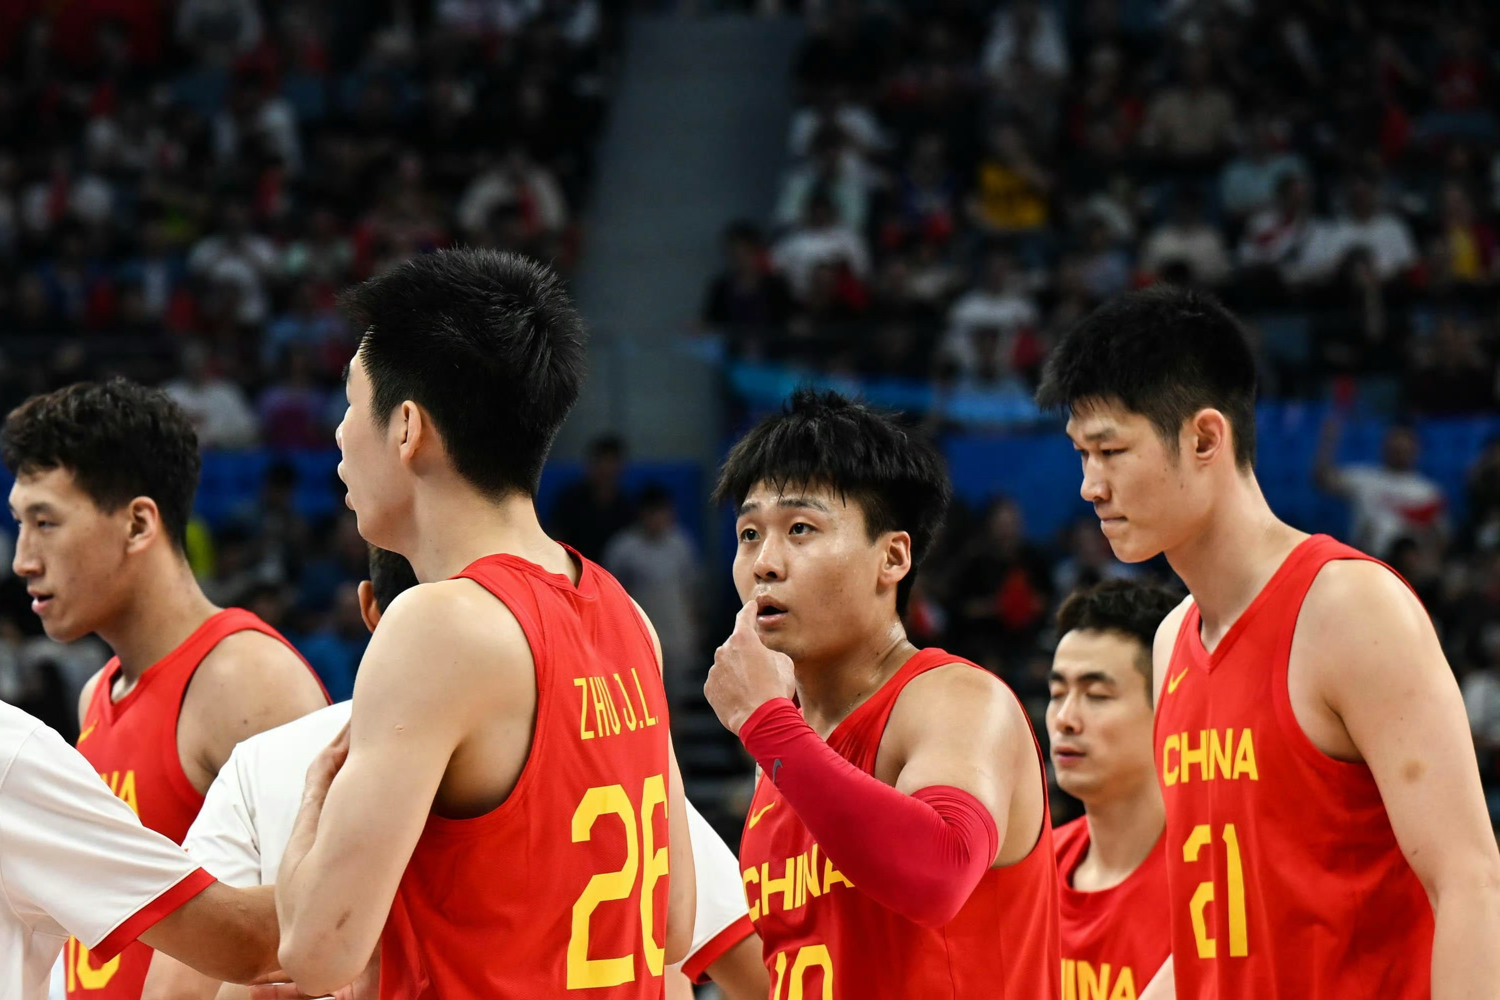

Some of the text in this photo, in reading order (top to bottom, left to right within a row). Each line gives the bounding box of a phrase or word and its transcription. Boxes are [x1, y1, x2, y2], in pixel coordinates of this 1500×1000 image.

[573, 676, 622, 740] ZHU
[1162, 727, 1260, 787] CHNA
[566, 773, 670, 990] 26
[1182, 822, 1249, 959] 21
